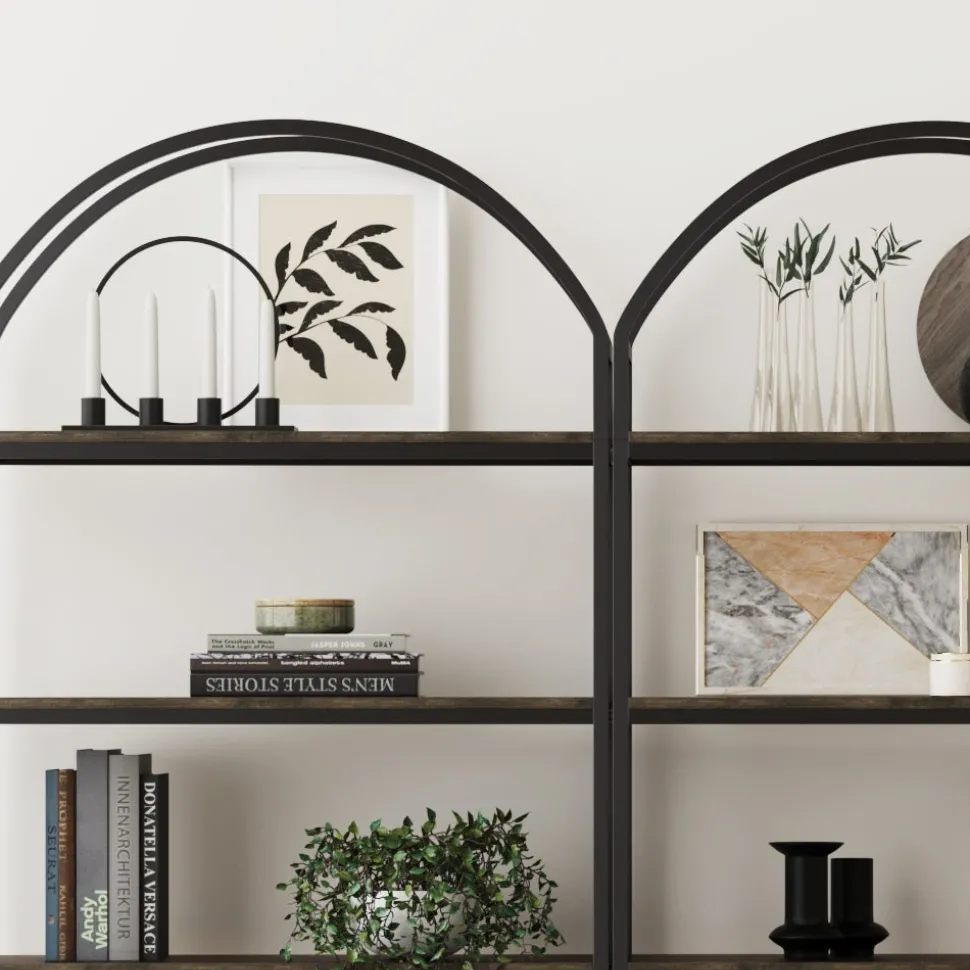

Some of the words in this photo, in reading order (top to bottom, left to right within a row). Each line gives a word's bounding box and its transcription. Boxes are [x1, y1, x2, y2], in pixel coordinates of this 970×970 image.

[311, 640, 338, 649] JASPER
[373, 640, 393, 648] GRAY
[205, 677, 279, 692] STORIES
[283, 677, 337, 692] STYLE
[341, 677, 395, 692] MEN'S
[58, 791, 68, 863] PROPHET
[143, 782, 156, 878] DONATELLA
[48, 826, 56, 894] SEURAT
[116, 776, 131, 940] INNENARCHITEKTUR
[59, 885, 67, 929] KAHLIL
[80, 897, 98, 942] Andy
[94, 890, 108, 950] Warhol
[143, 881, 156, 954] VERSACE
